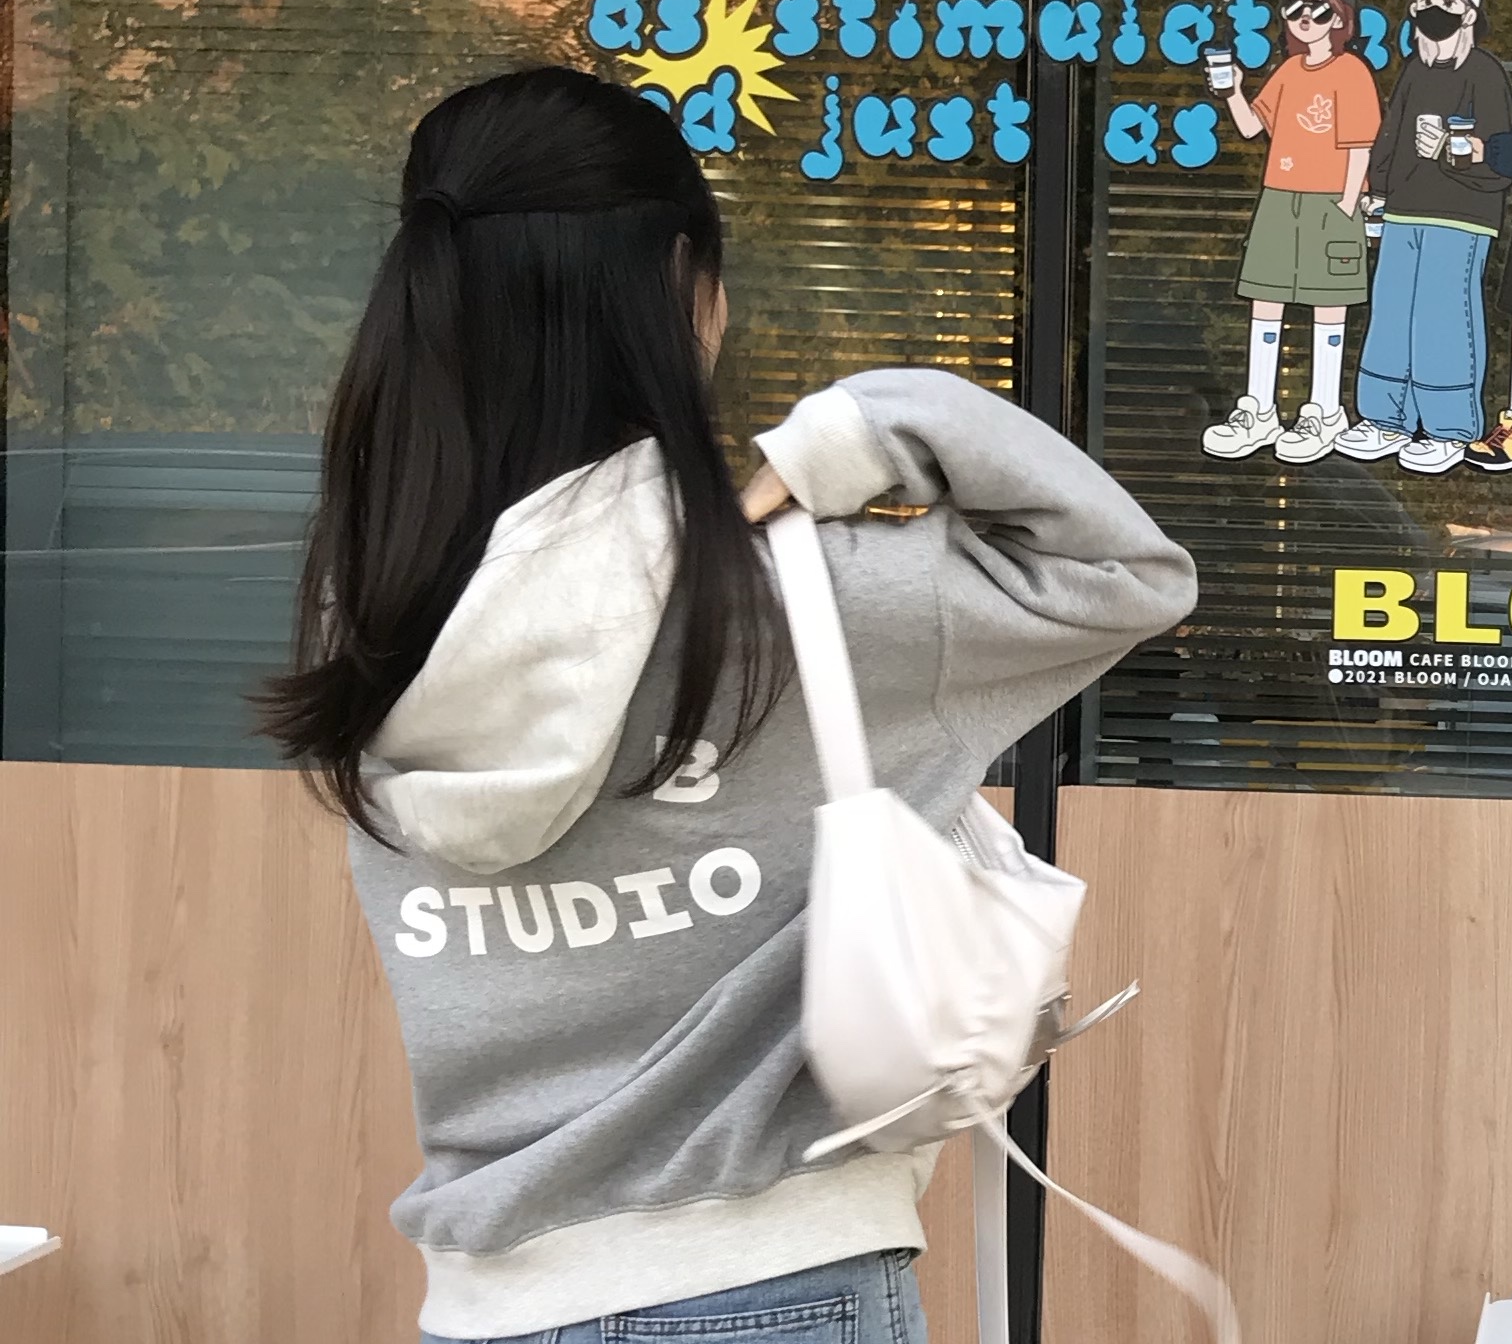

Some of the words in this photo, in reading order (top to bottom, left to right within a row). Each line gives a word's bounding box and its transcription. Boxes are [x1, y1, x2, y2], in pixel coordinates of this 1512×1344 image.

[800, 74, 1034, 182] just
[1102, 100, 1222, 169] as
[1328, 649, 1403, 667] BLOOM
[1409, 653, 1454, 667] CAFE
[1394, 671, 1458, 686] BLOOM
[1462, 672, 1472, 688] /
[394, 846, 762, 957] STUDIO
